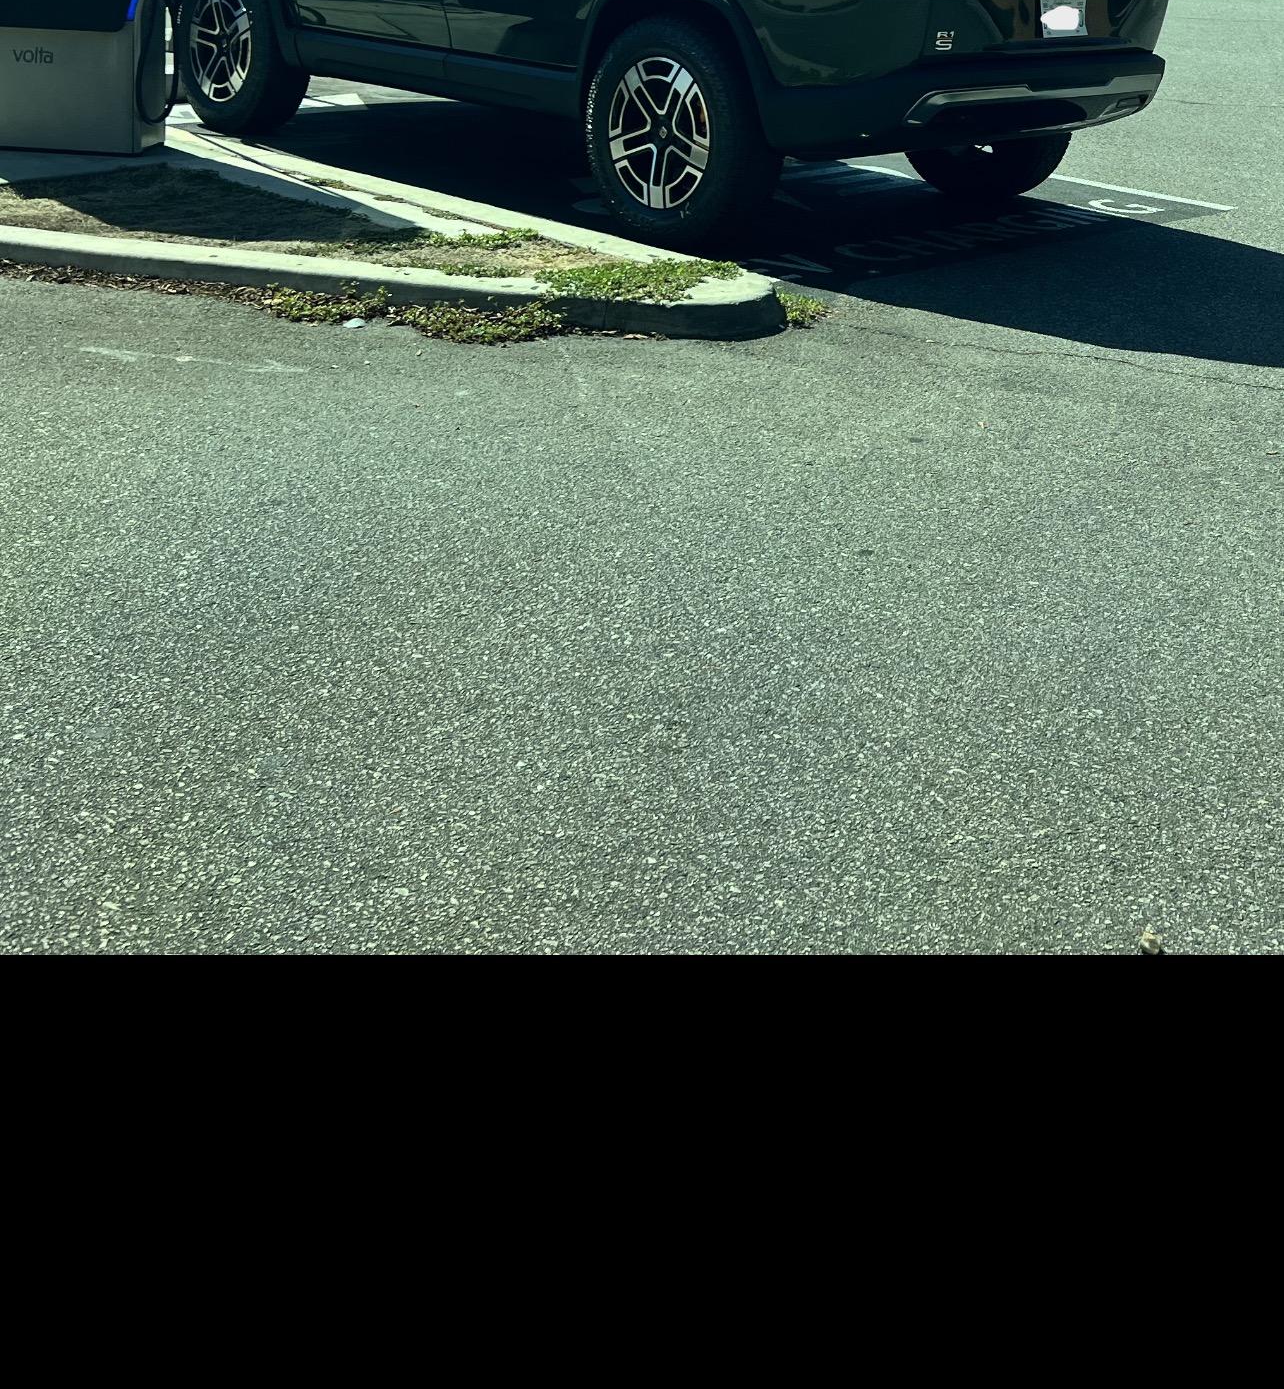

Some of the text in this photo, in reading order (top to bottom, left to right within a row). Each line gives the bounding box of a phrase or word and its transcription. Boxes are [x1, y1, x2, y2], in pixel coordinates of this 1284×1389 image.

[936, 30, 955, 38] R1
[935, 39, 953, 51] S
[12, 47, 54, 64] volta
